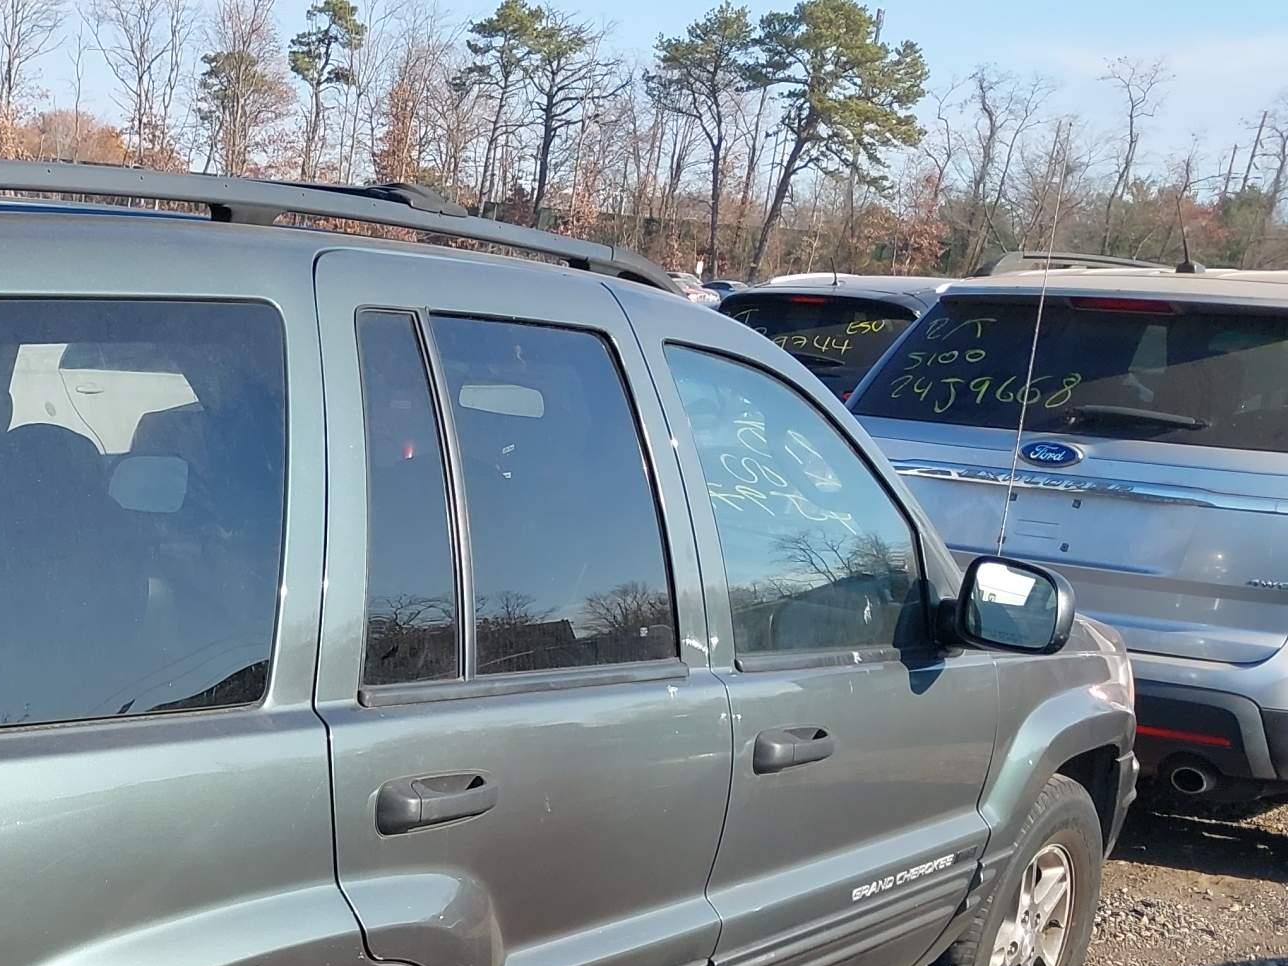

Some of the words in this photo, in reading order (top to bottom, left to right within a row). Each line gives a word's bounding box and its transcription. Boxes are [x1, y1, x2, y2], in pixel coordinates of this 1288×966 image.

[1029, 444, 1066, 463] Ford
[851, 875, 895, 902] GRAND
[895, 853, 955, 886] CHEROKEE
